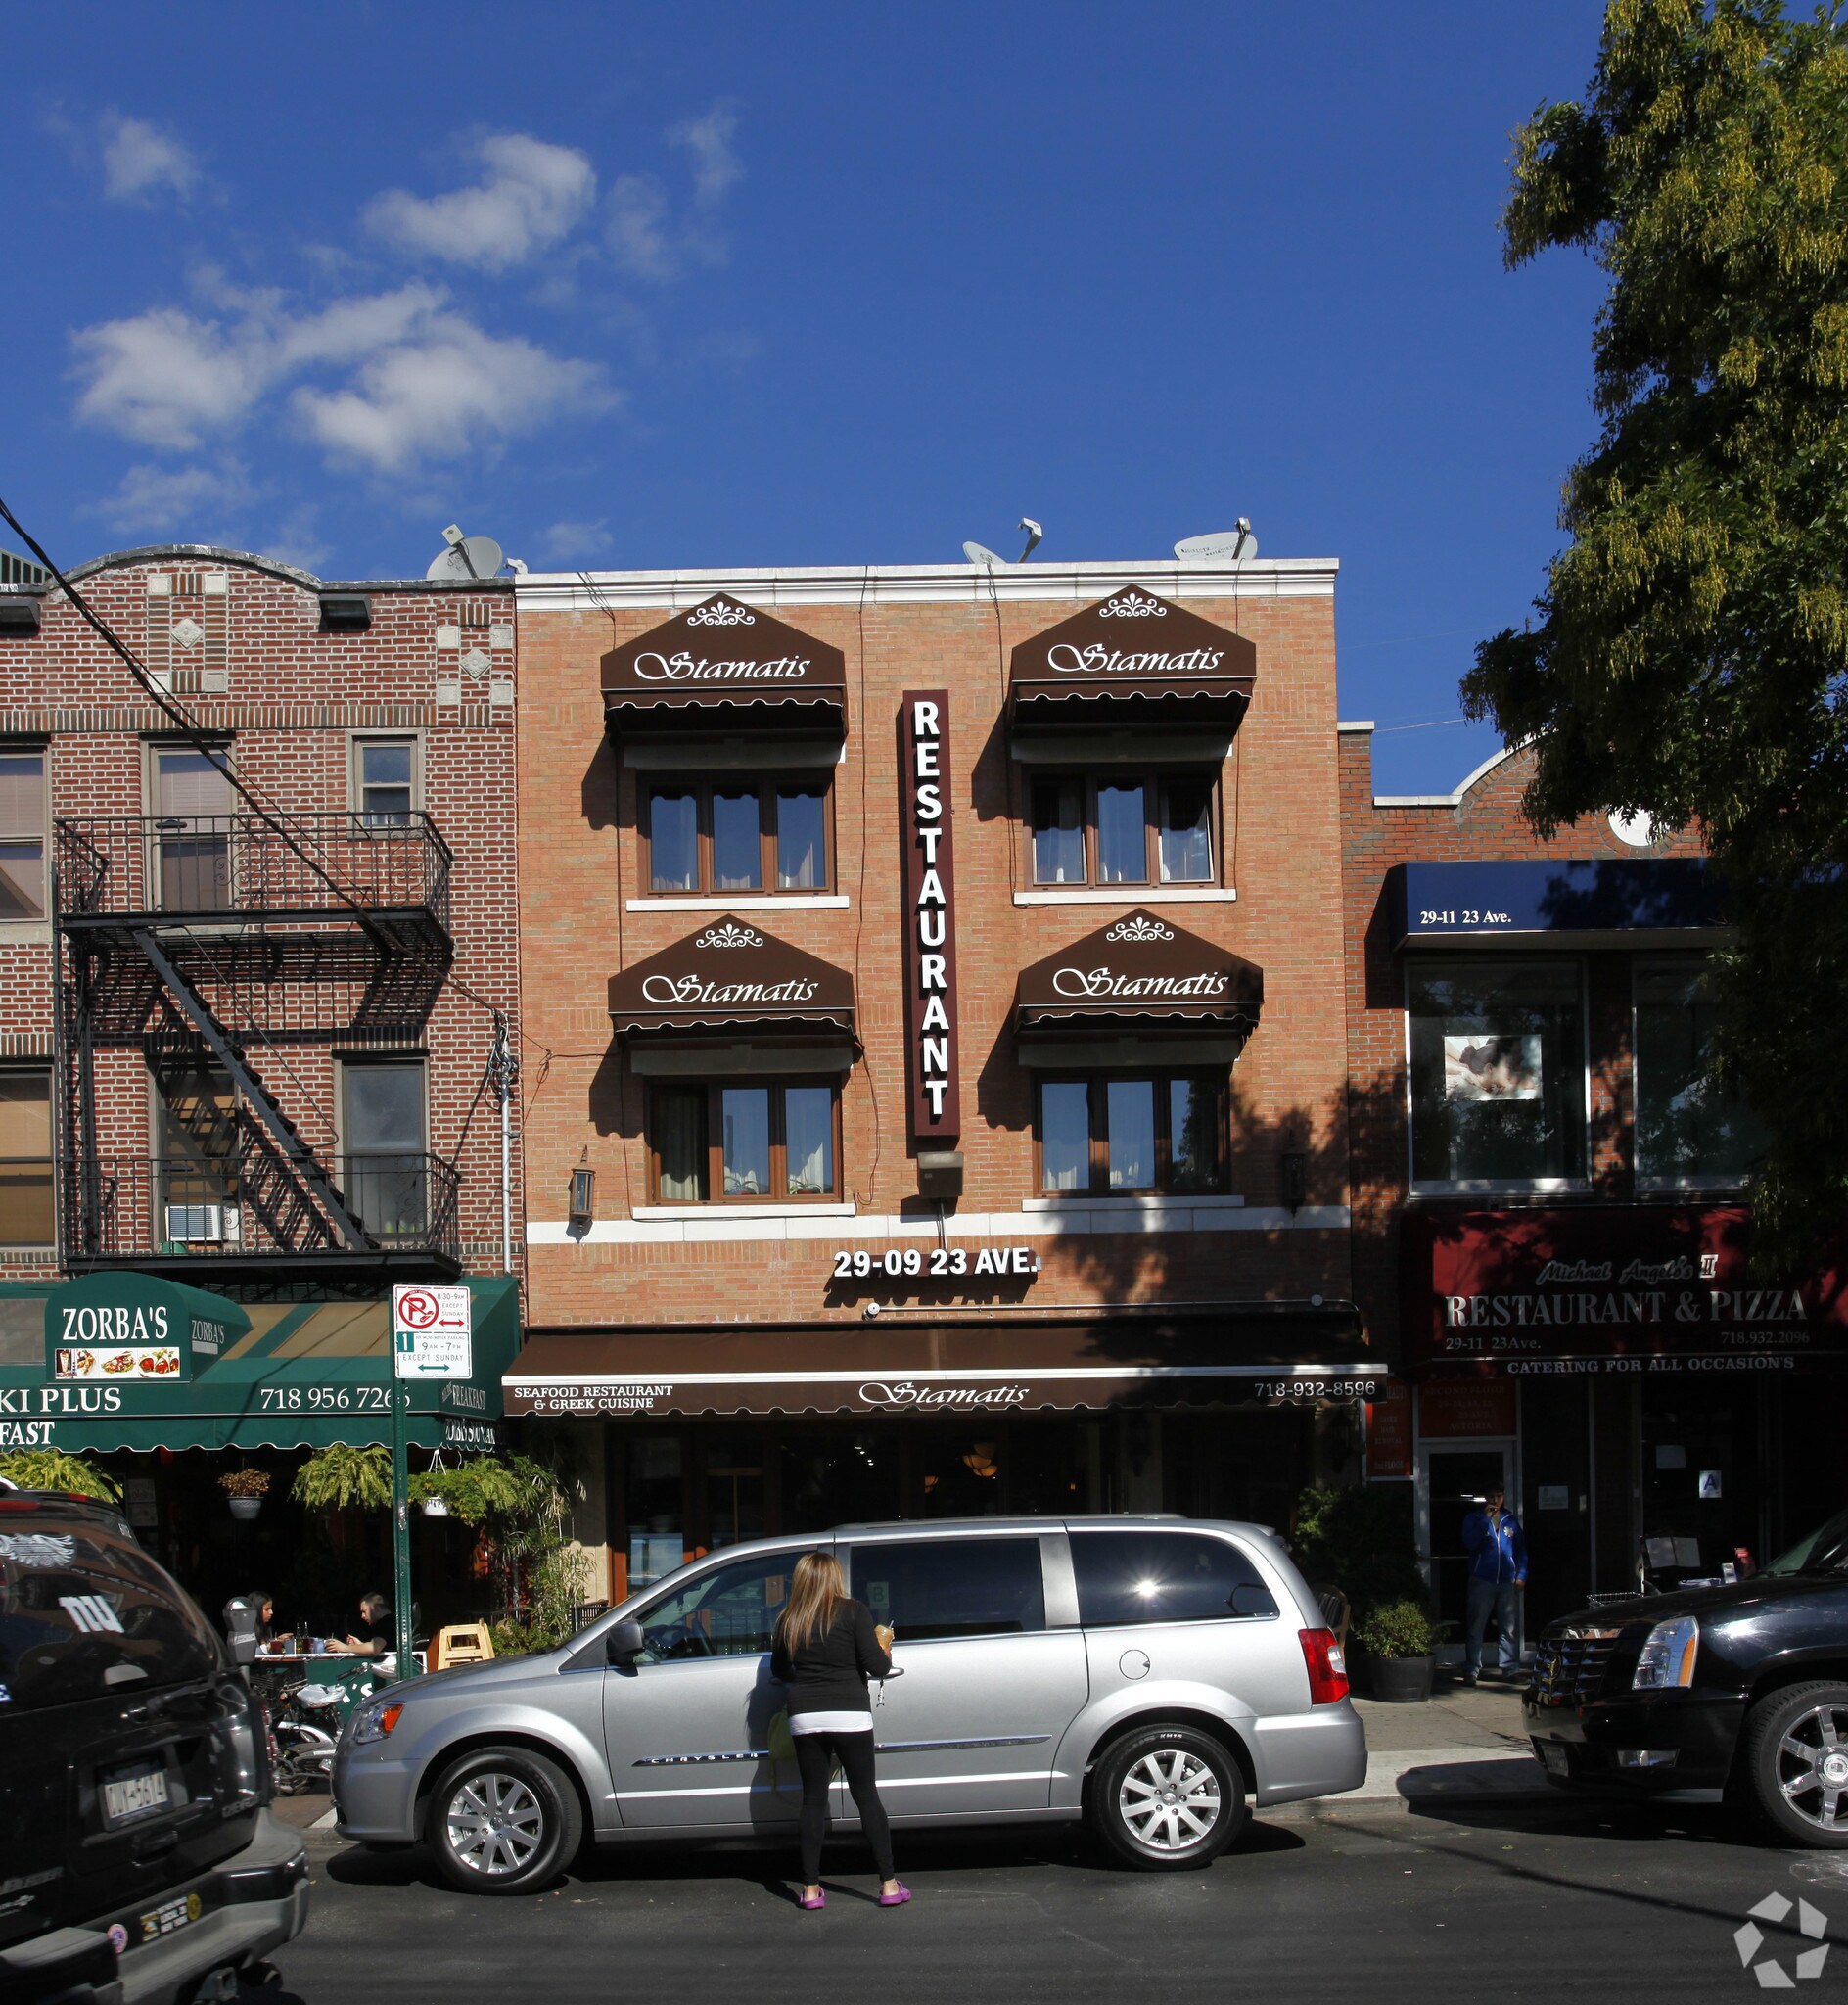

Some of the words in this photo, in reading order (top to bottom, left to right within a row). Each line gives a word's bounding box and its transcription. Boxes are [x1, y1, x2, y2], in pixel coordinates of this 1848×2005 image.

[633, 649, 811, 681] Stamatis
[1047, 641, 1224, 674] Stamatis
[913, 700, 948, 1115] RESTAURANT
[1420, 910, 1455, 924] 29-11
[1462, 910, 1479, 924] 23
[1483, 910, 1512, 923] Ave.
[641, 972, 820, 1005] Stamatis
[1051, 966, 1229, 999] Stamatis
[833, 1248, 922, 1278] 29-09
[930, 1248, 967, 1275] 23
[974, 1246, 1038, 1275] AVE.
[1535, 1259, 1613, 1286] Michael
[1618, 1255, 1694, 1284] Angelo's
[1444, 1291, 1666, 1328] RESTAURANT
[1674, 1290, 1702, 1323] &
[1709, 1288, 1808, 1322] PIZZA
[62, 1306, 169, 1341] ZORBA'S
[191, 1320, 225, 1345] ZORBA'S
[402, 1333, 408, 1351] 1
[1445, 1337, 1483, 1350] 29-11
[1721, 1331, 1810, 1345] 718.932.2096
[1507, 1360, 1599, 1374] CATERING
[1605, 1359, 1643, 1372] FOR
[1648, 1358, 1683, 1372] ALL
[1687, 1357, 1794, 1371] OCCASION'S
[39, 1387, 122, 1413] PLUS
[260, 1388, 301, 1410] 718
[307, 1387, 349, 1409] 956
[452, 1384, 486, 1411] BREAKFAST
[514, 1386, 579, 1398] SEAFOOD
[583, 1385, 673, 1397] RESTAURANT
[858, 1381, 1030, 1404] Stamatis
[1254, 1380, 1376, 1397] 718-932-8596
[534, 1399, 545, 1410] &
[549, 1399, 595, 1409] GREEK
[598, 1397, 654, 1409] CUISINE
[0, 1422, 55, 1446] FAST
[1703, 1473, 1718, 1491] A
[651, 1752, 759, 1764] CHRYSLER
